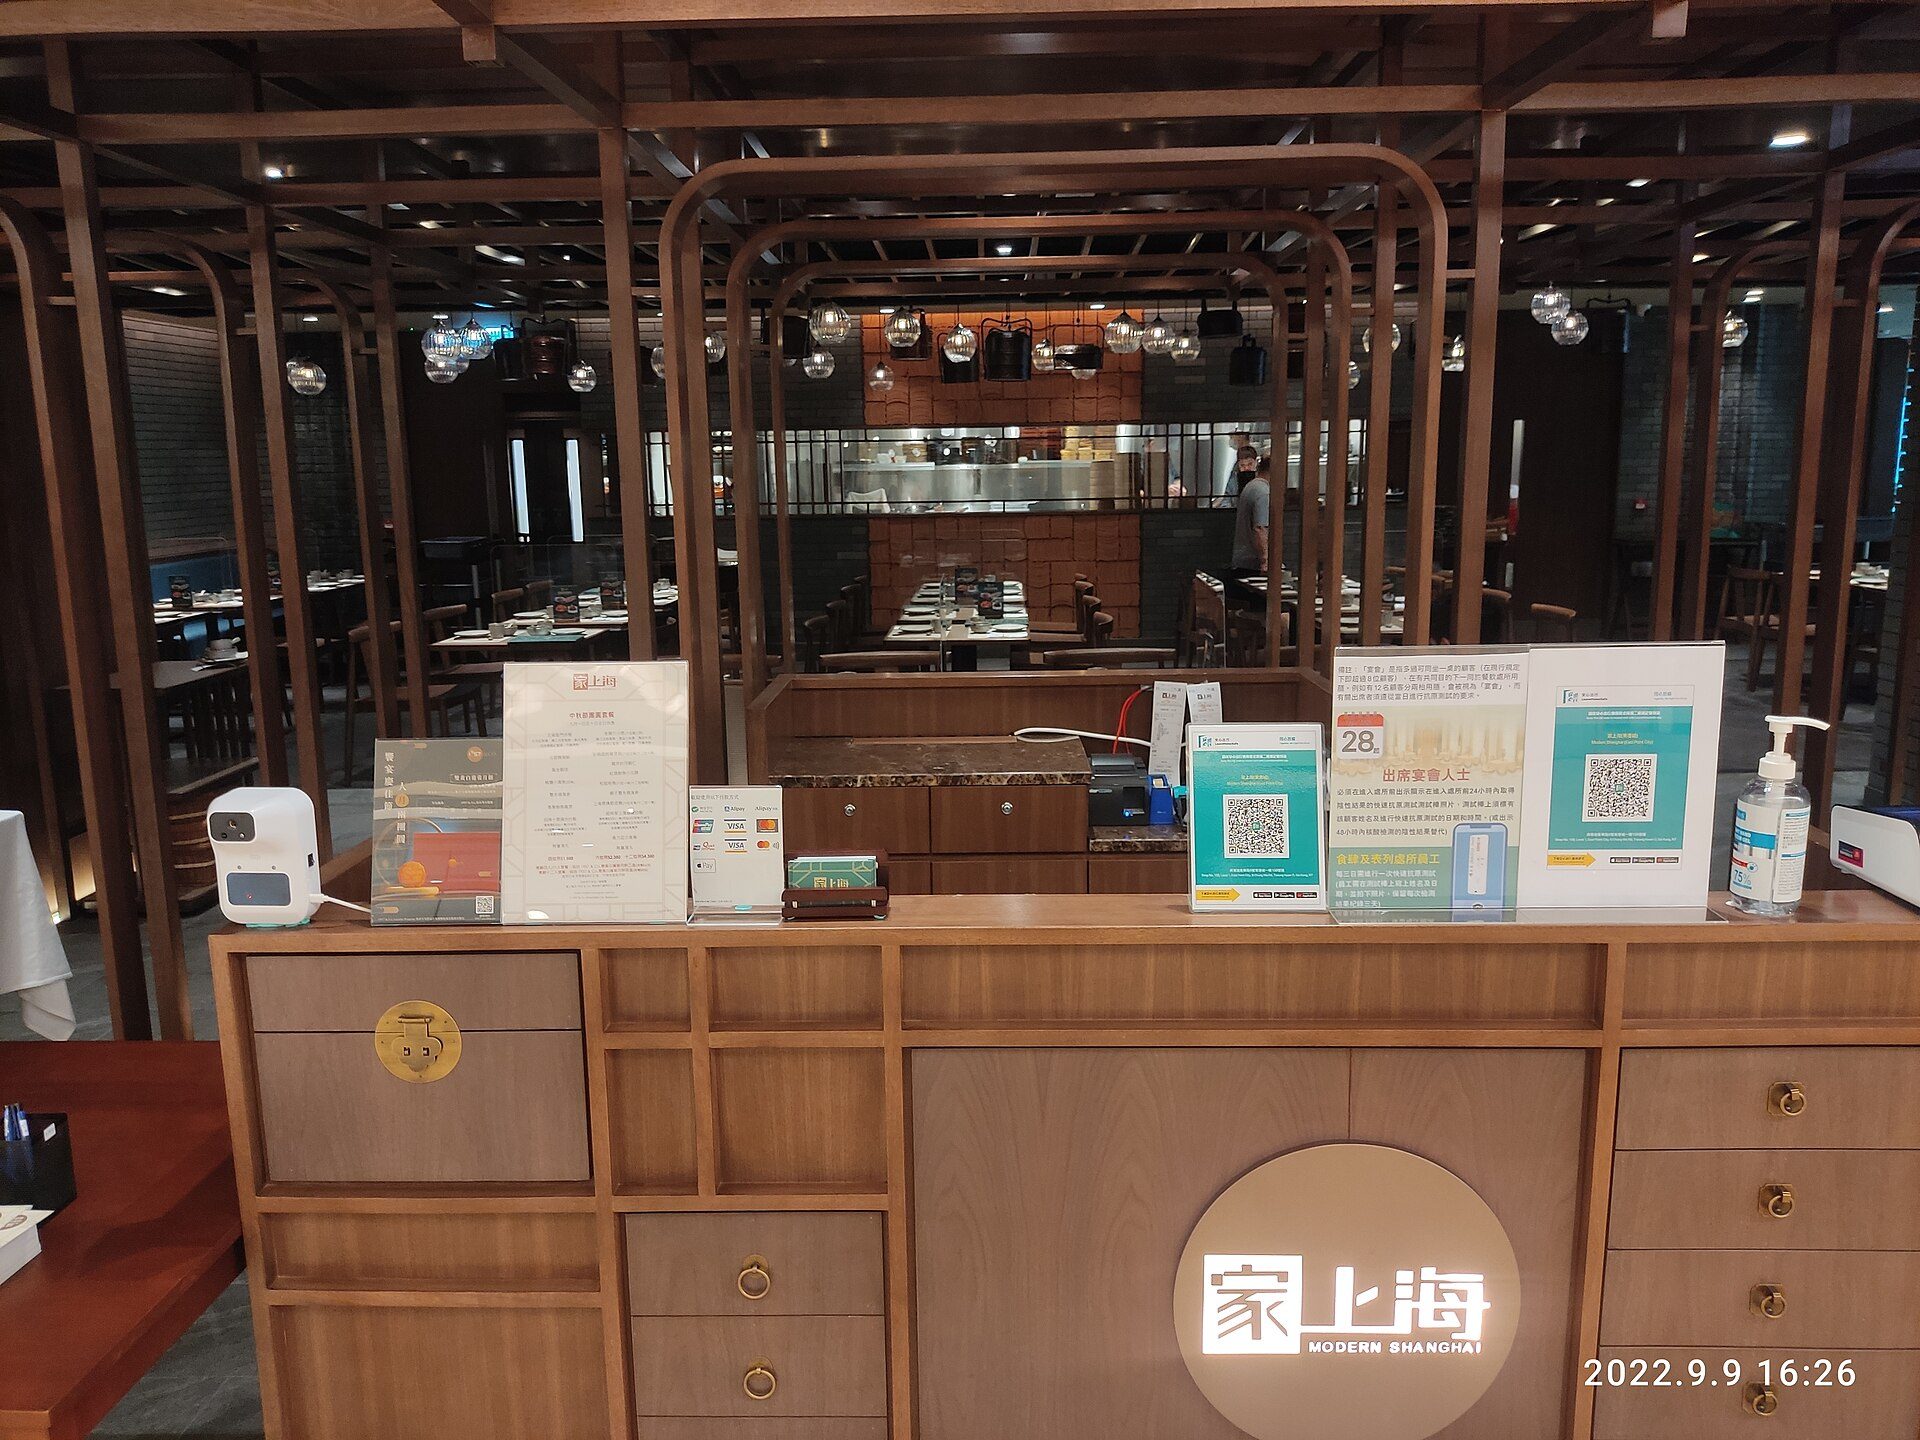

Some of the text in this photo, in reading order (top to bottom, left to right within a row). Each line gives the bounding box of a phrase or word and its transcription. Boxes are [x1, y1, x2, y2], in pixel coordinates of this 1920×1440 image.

[573, 673, 617, 690] 家上海
[1341, 730, 1374, 753] 28
[1382, 768, 1471, 782] 出席宴會人士
[1734, 869, 1752, 886] 75%
[1202, 1253, 1492, 1355] 家上海
[1308, 1341, 1482, 1354] MODERN SHANGHAI
